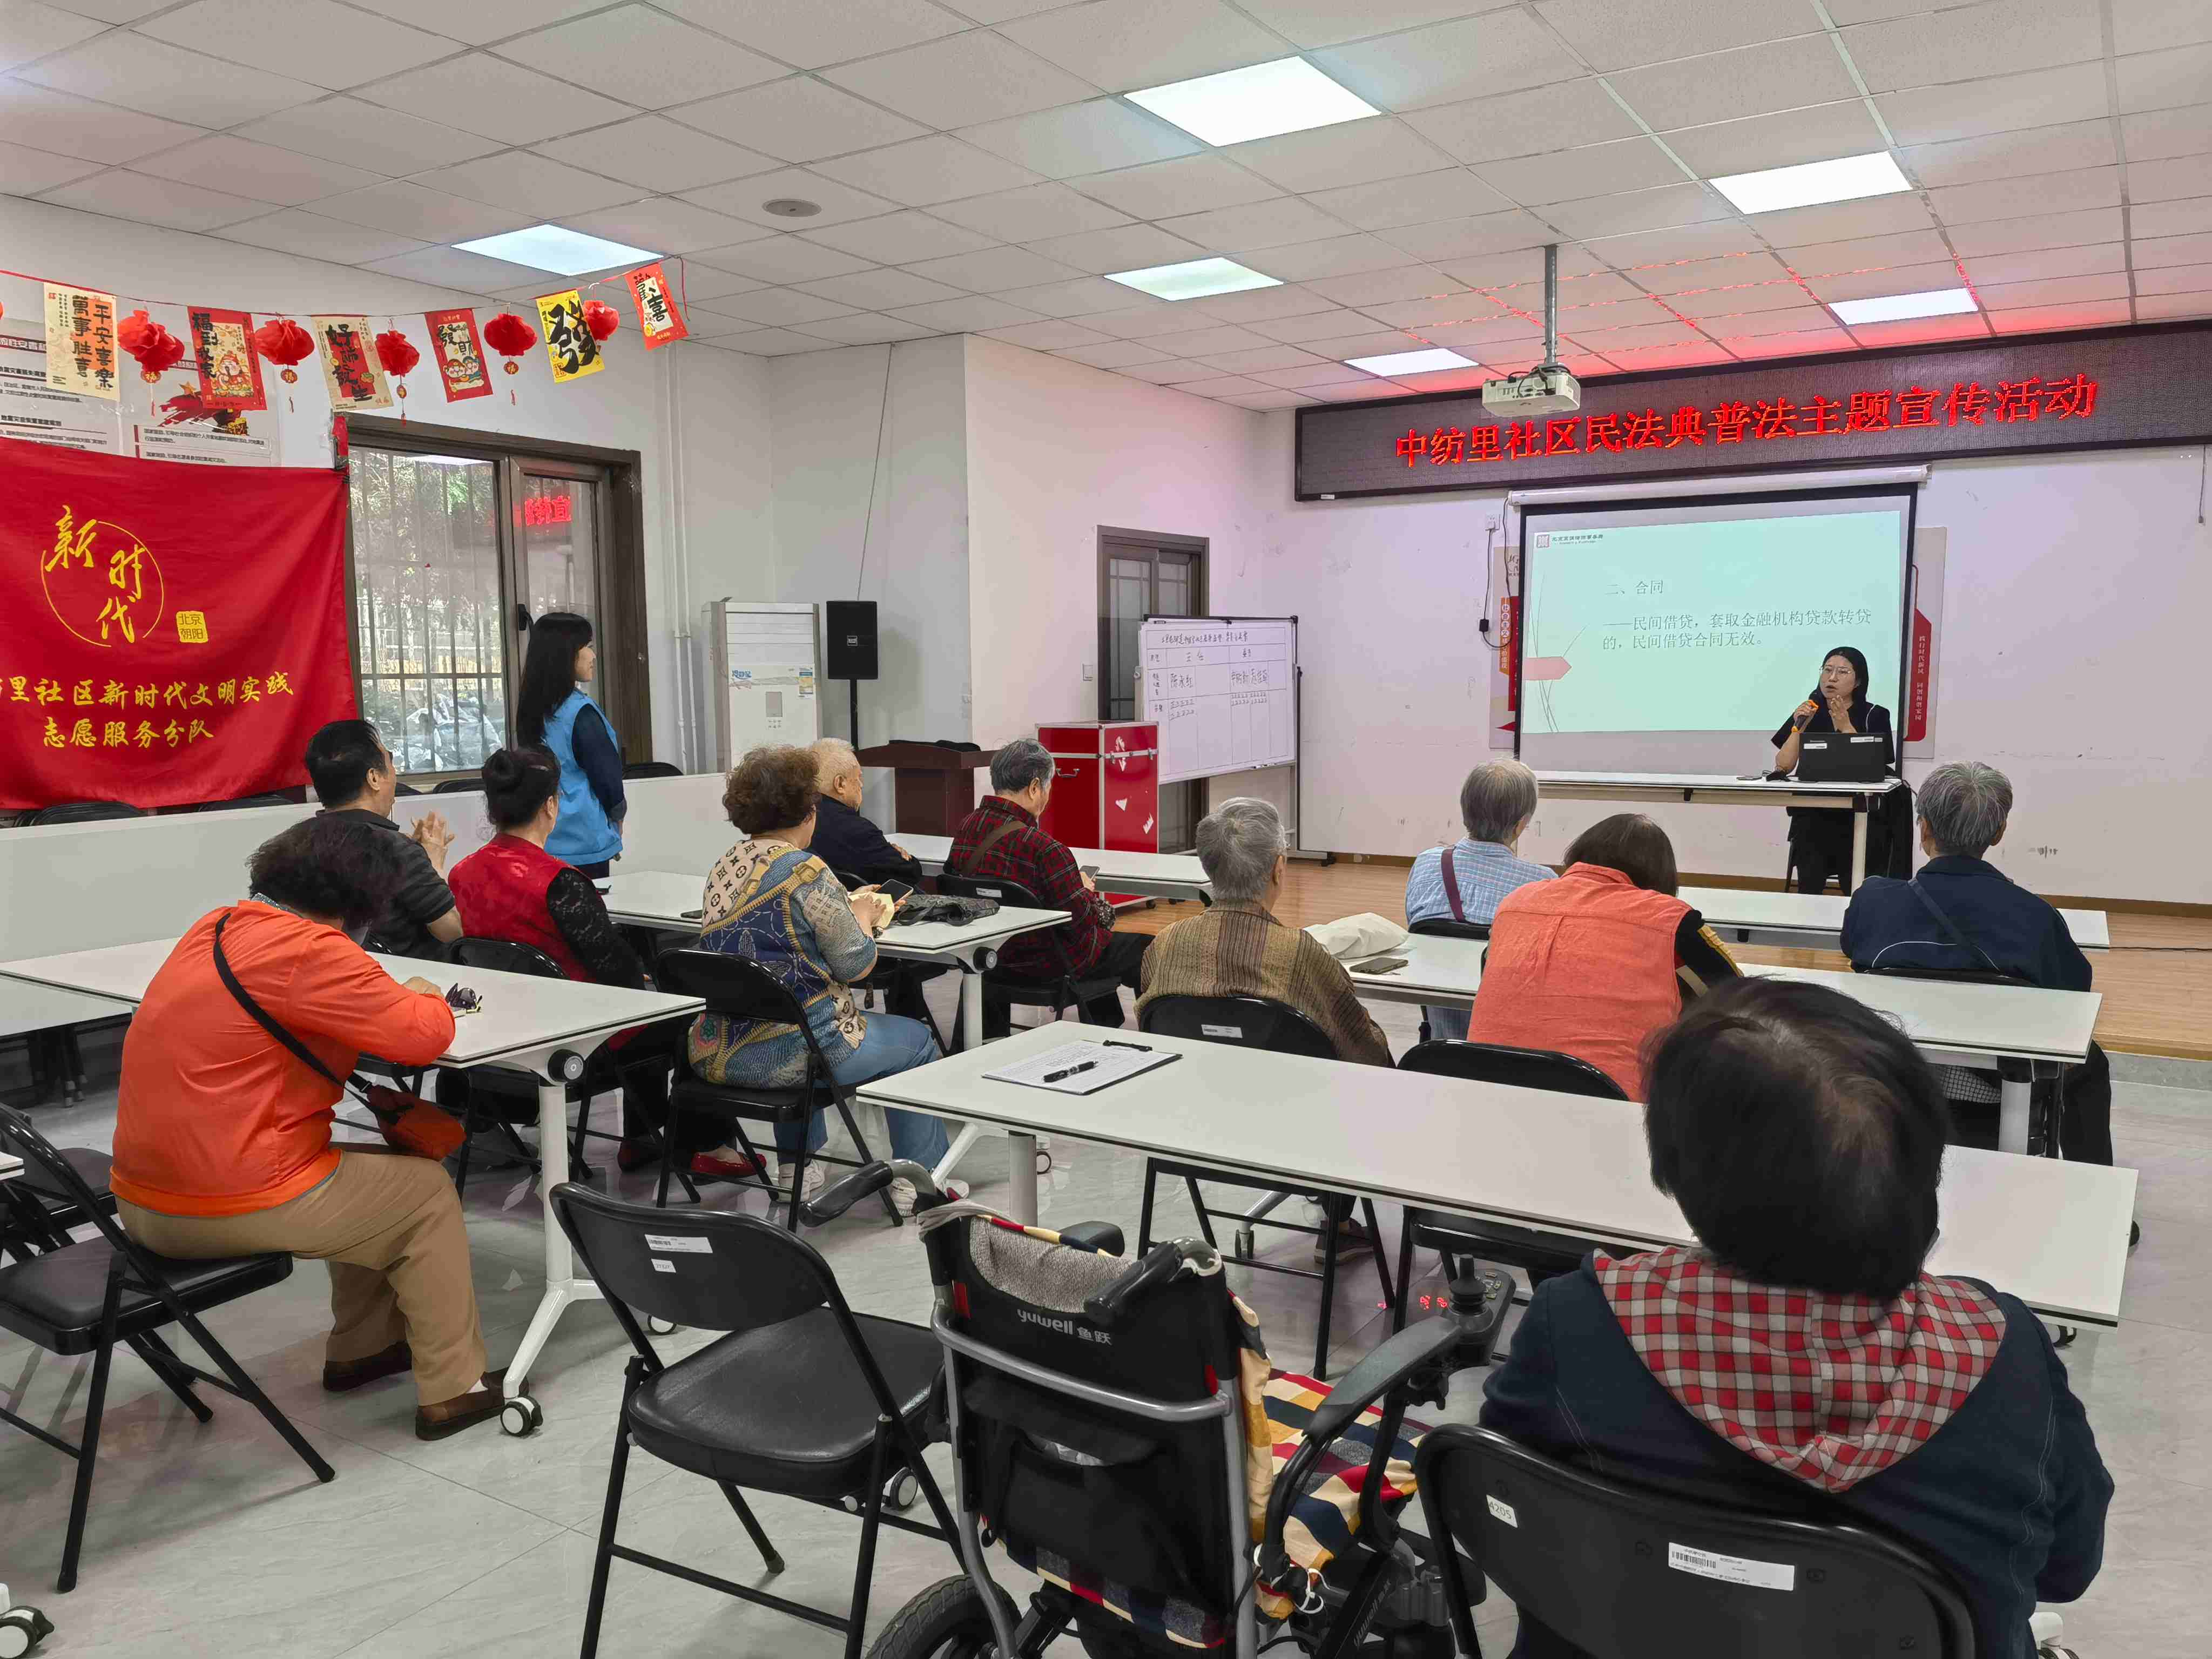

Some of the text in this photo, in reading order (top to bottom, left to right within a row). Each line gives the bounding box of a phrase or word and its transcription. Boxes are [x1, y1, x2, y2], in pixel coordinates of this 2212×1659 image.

[1396, 374, 2098, 468] 中纺里社区民法典普法主题宣传活动
[45, 505, 146, 643] 新时代
[179, 613, 201, 626] 北京
[180, 628, 204, 640] 朝阳
[43, 716, 214, 748] 志愿服务分队
[1017, 1309, 1112, 1346] yuwell 鱼跃
